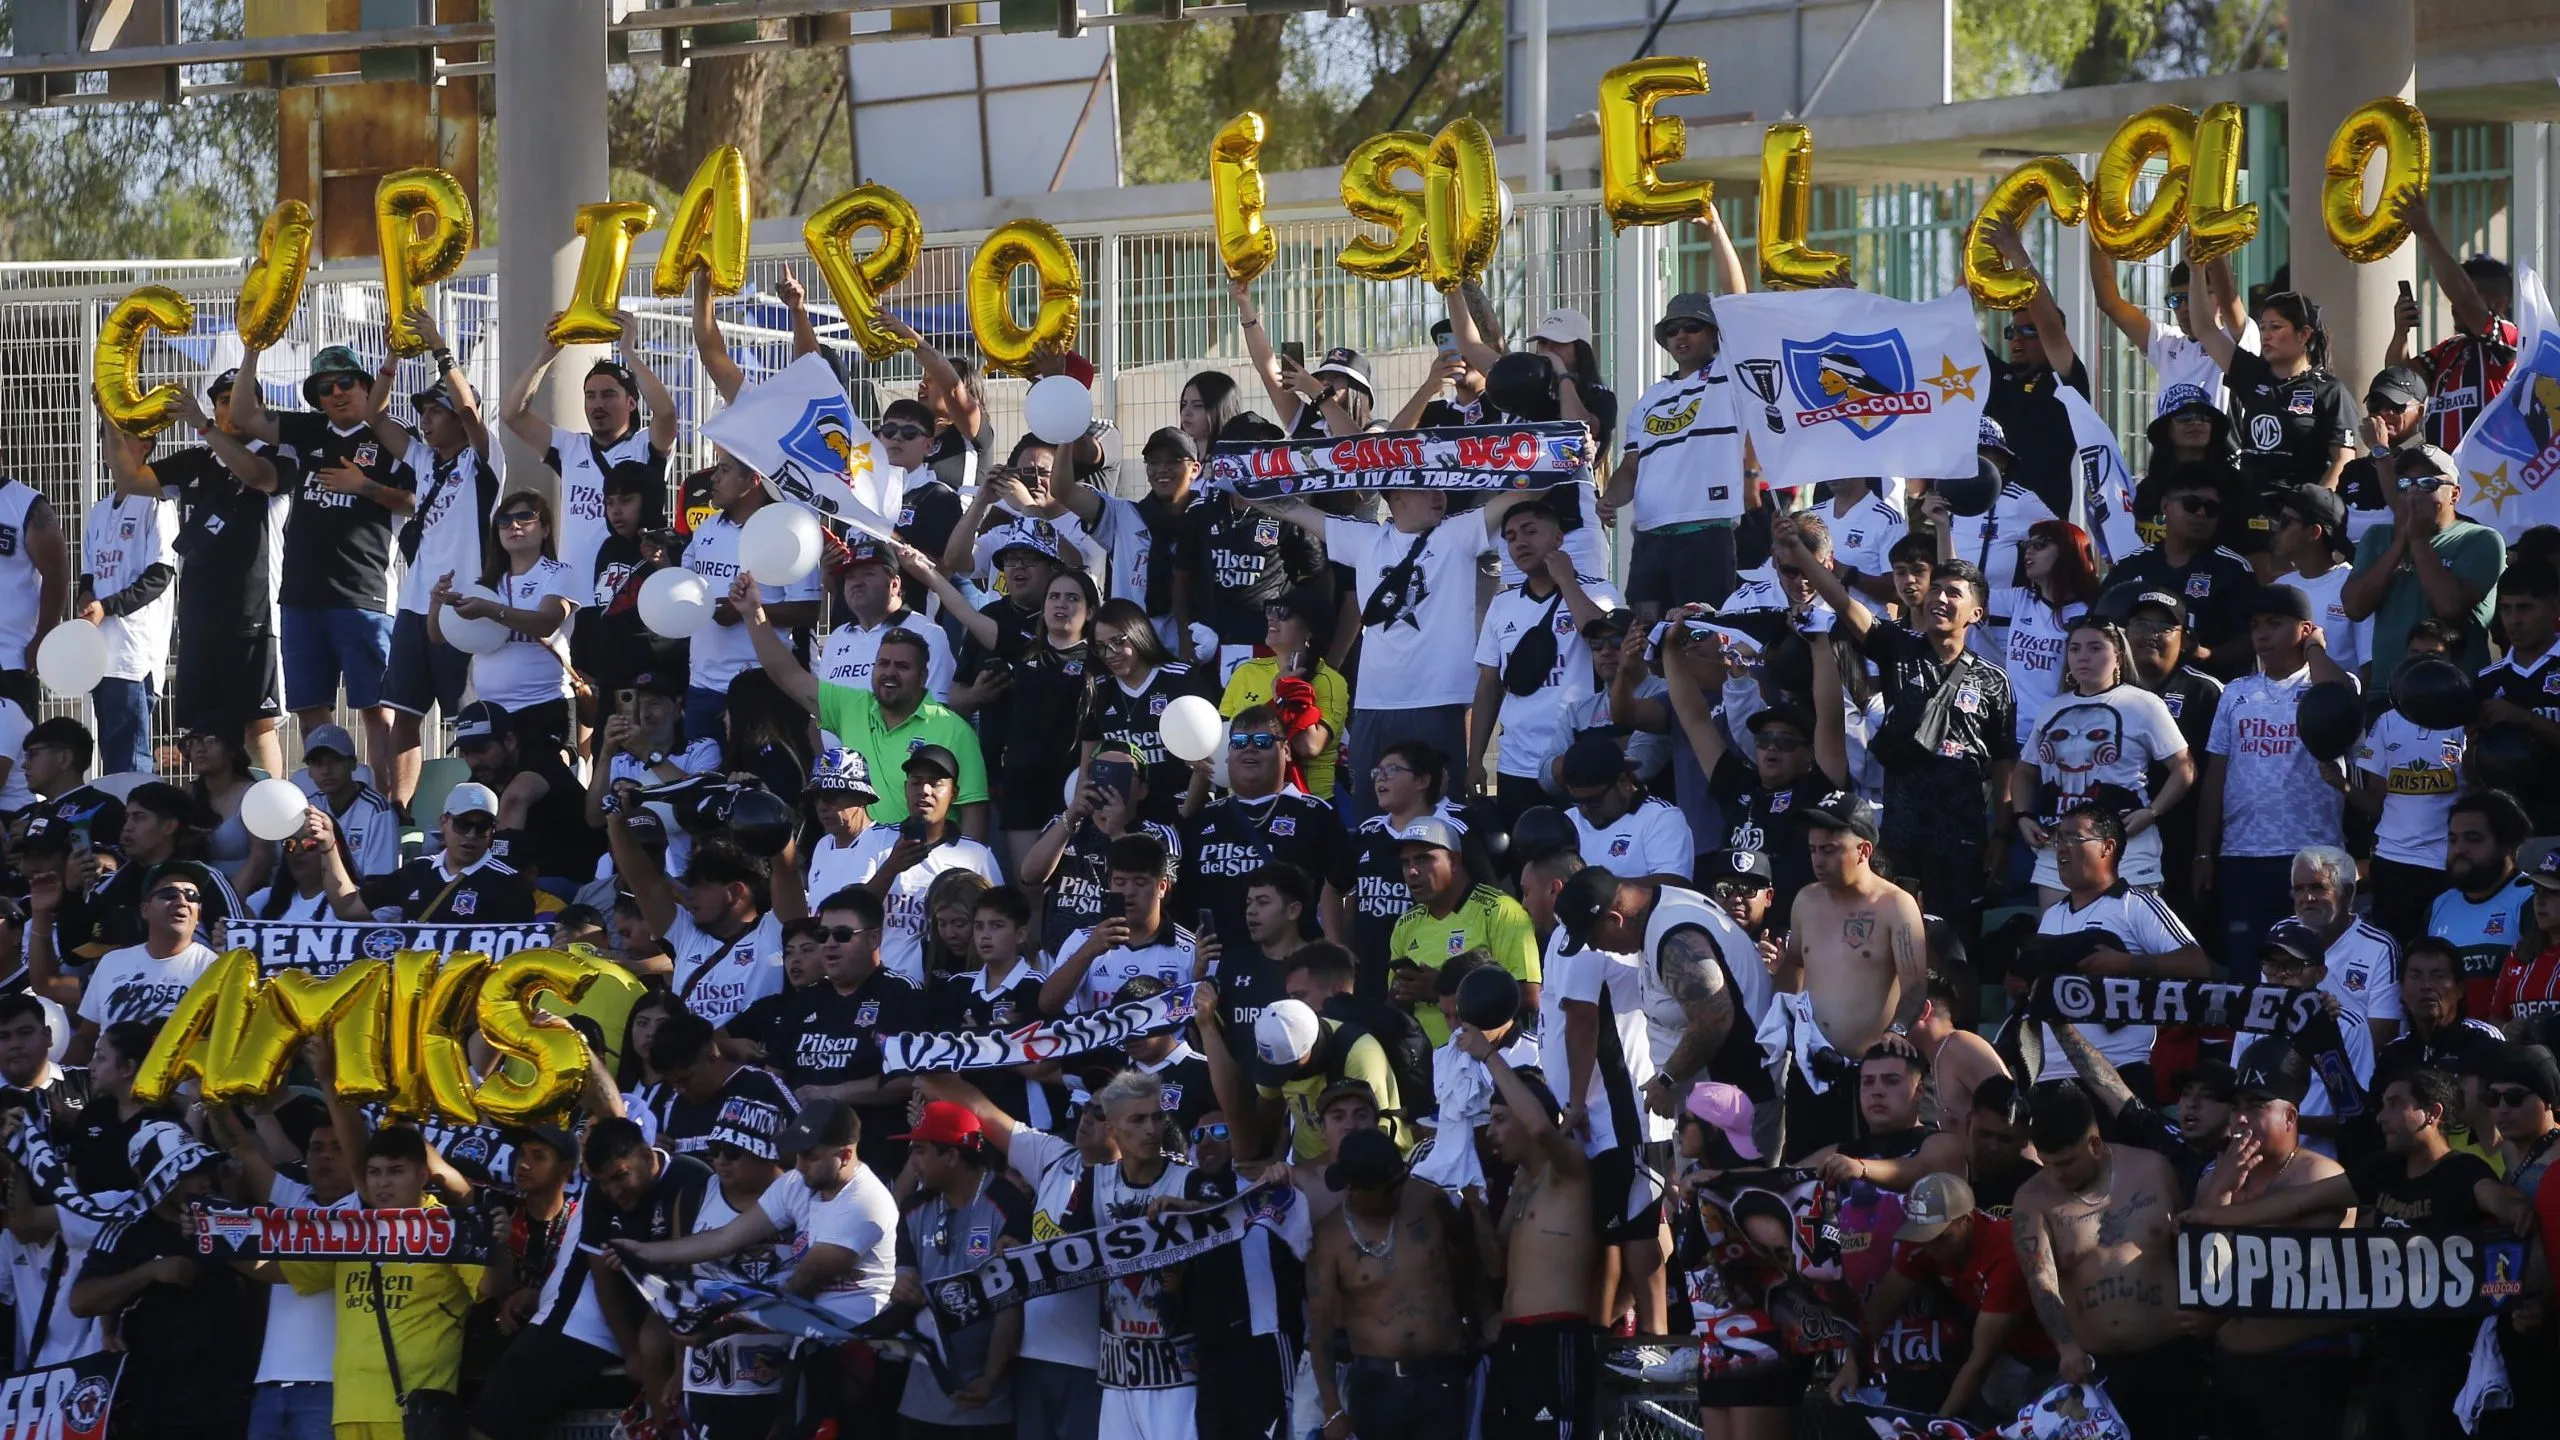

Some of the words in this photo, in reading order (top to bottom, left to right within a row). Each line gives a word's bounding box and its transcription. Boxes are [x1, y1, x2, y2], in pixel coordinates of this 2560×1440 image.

[1939, 374, 1968, 391] 33
[1799, 393, 1930, 427] COLO-COLO
[1250, 446, 1297, 480] LA
[1300, 472, 1330, 491] DE
[1332, 470, 1363, 489] LA
[1364, 470, 1386, 488] IV
[1387, 470, 1418, 488] AL
[1421, 469, 1510, 489] TABLON
[570, 485, 605, 504] Pils
[695, 559, 741, 578] DIRECT
[2010, 630, 2065, 656] Pilsen
[829, 662, 876, 680] DIRECT
[2024, 651, 2059, 672] Sur
[2241, 738, 2260, 753] del
[2259, 737, 2297, 758] Sur
[2390, 769, 2451, 791] CRISTAL
[1200, 860, 1225, 876] del
[887, 893, 925, 916] Pils
[1076, 896, 1101, 915] Su
[1358, 898, 1373, 913] del
[800, 1031, 858, 1053] Pilsen
[797, 1050, 818, 1067] del
[815, 1050, 853, 1071] Sur
[253, 1205, 454, 1256] MALDITOS
